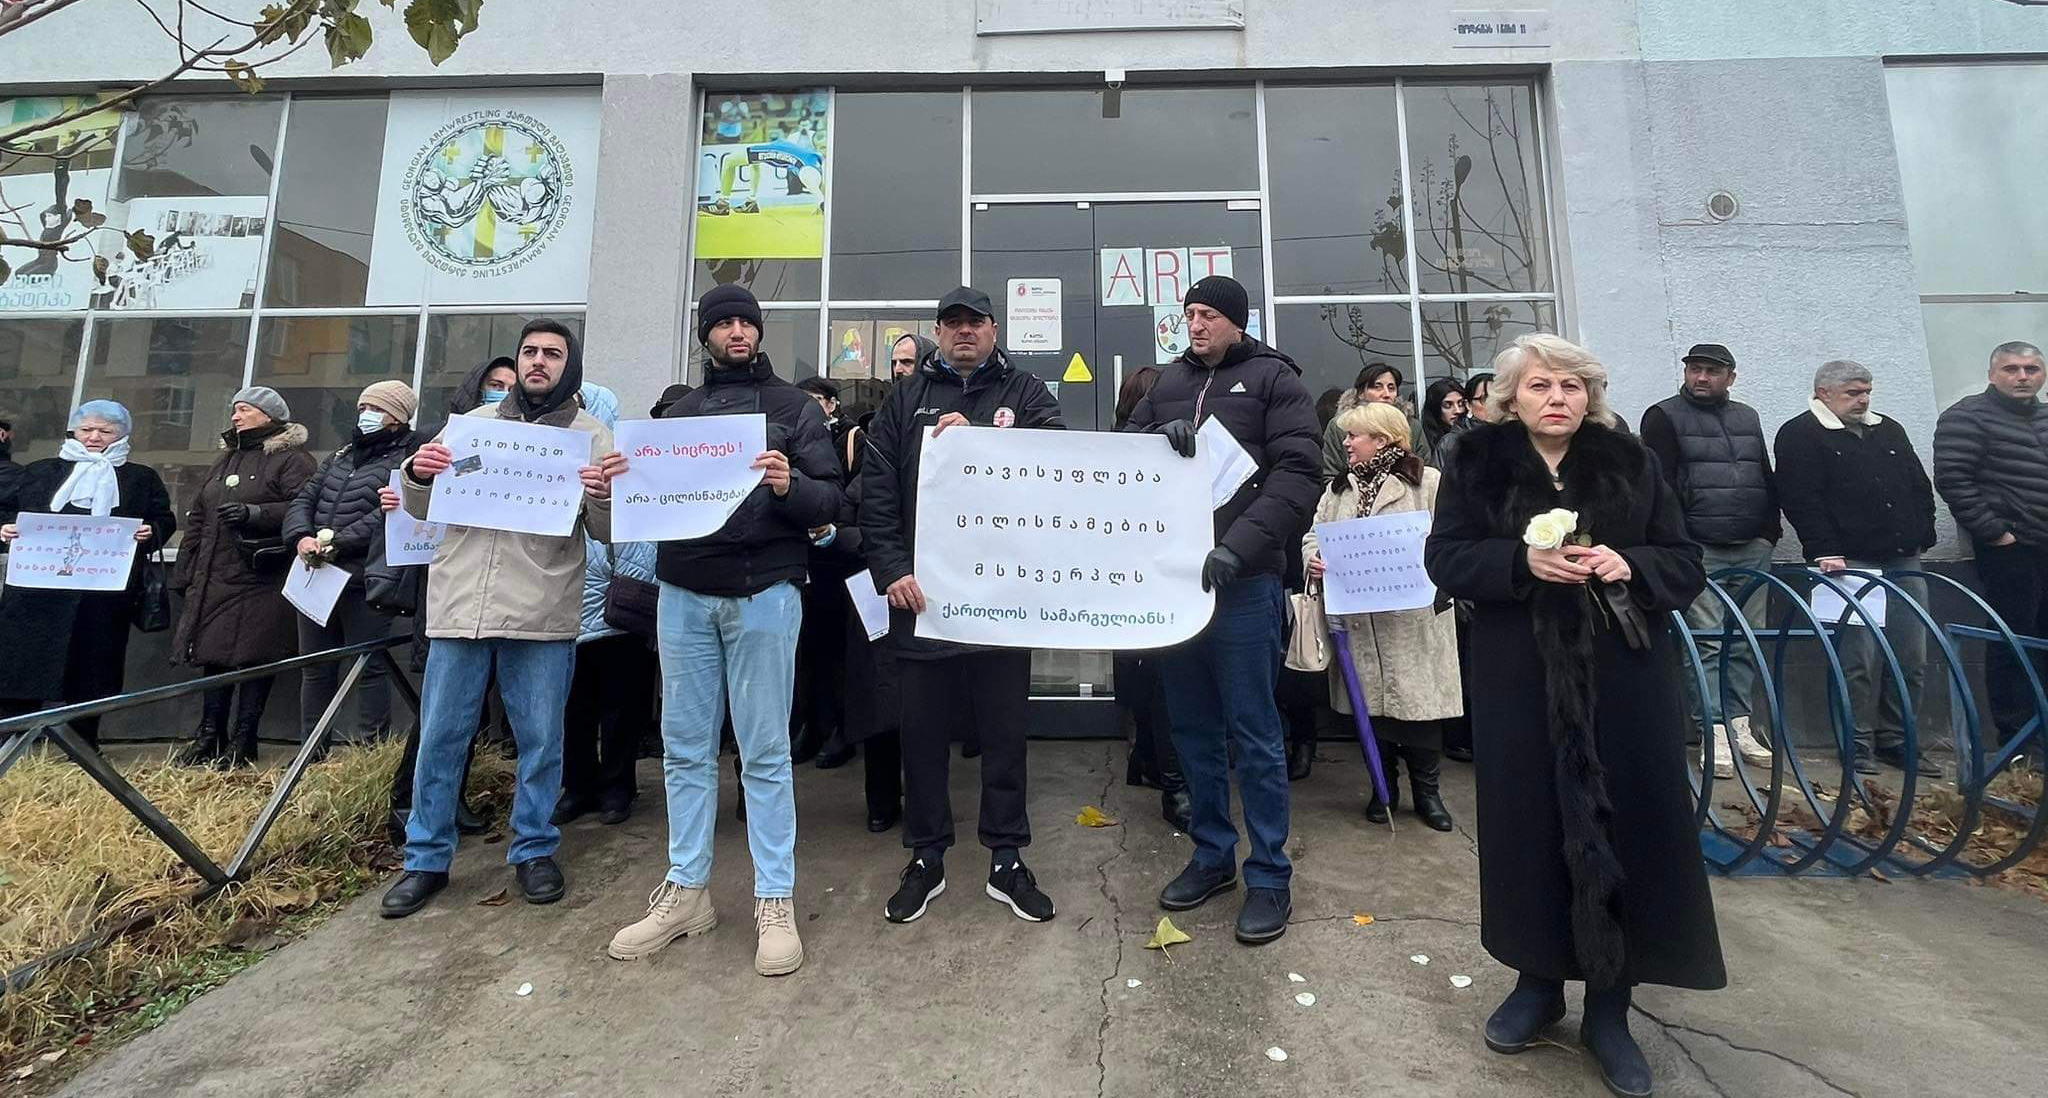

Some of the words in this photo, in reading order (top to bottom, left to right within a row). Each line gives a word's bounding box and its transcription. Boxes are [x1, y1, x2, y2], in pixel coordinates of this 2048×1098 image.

[403, 146, 431, 191] GEORGIAN
[431, 109, 501, 143] ARMWRESTLING
[545, 195, 572, 240] GEORGIAN
[472, 243, 547, 279] ARMWRESTLING
[471, 438, 564, 457] ვითხოვთ
[635, 445, 661, 457] არა
[672, 442, 735, 457] სიცრუეს
[482, 467, 566, 482] კანონიერ
[963, 464, 1162, 484] თავისუფლება
[445, 487, 569, 507] გამოძიებას
[626, 493, 650, 504] არა
[956, 514, 1166, 534] ცილისწამების
[974, 563, 1144, 585] მსხვერპლს
[942, 603, 1028, 623] ქართლოს
[1040, 607, 1166, 627] სამარგულიანს
